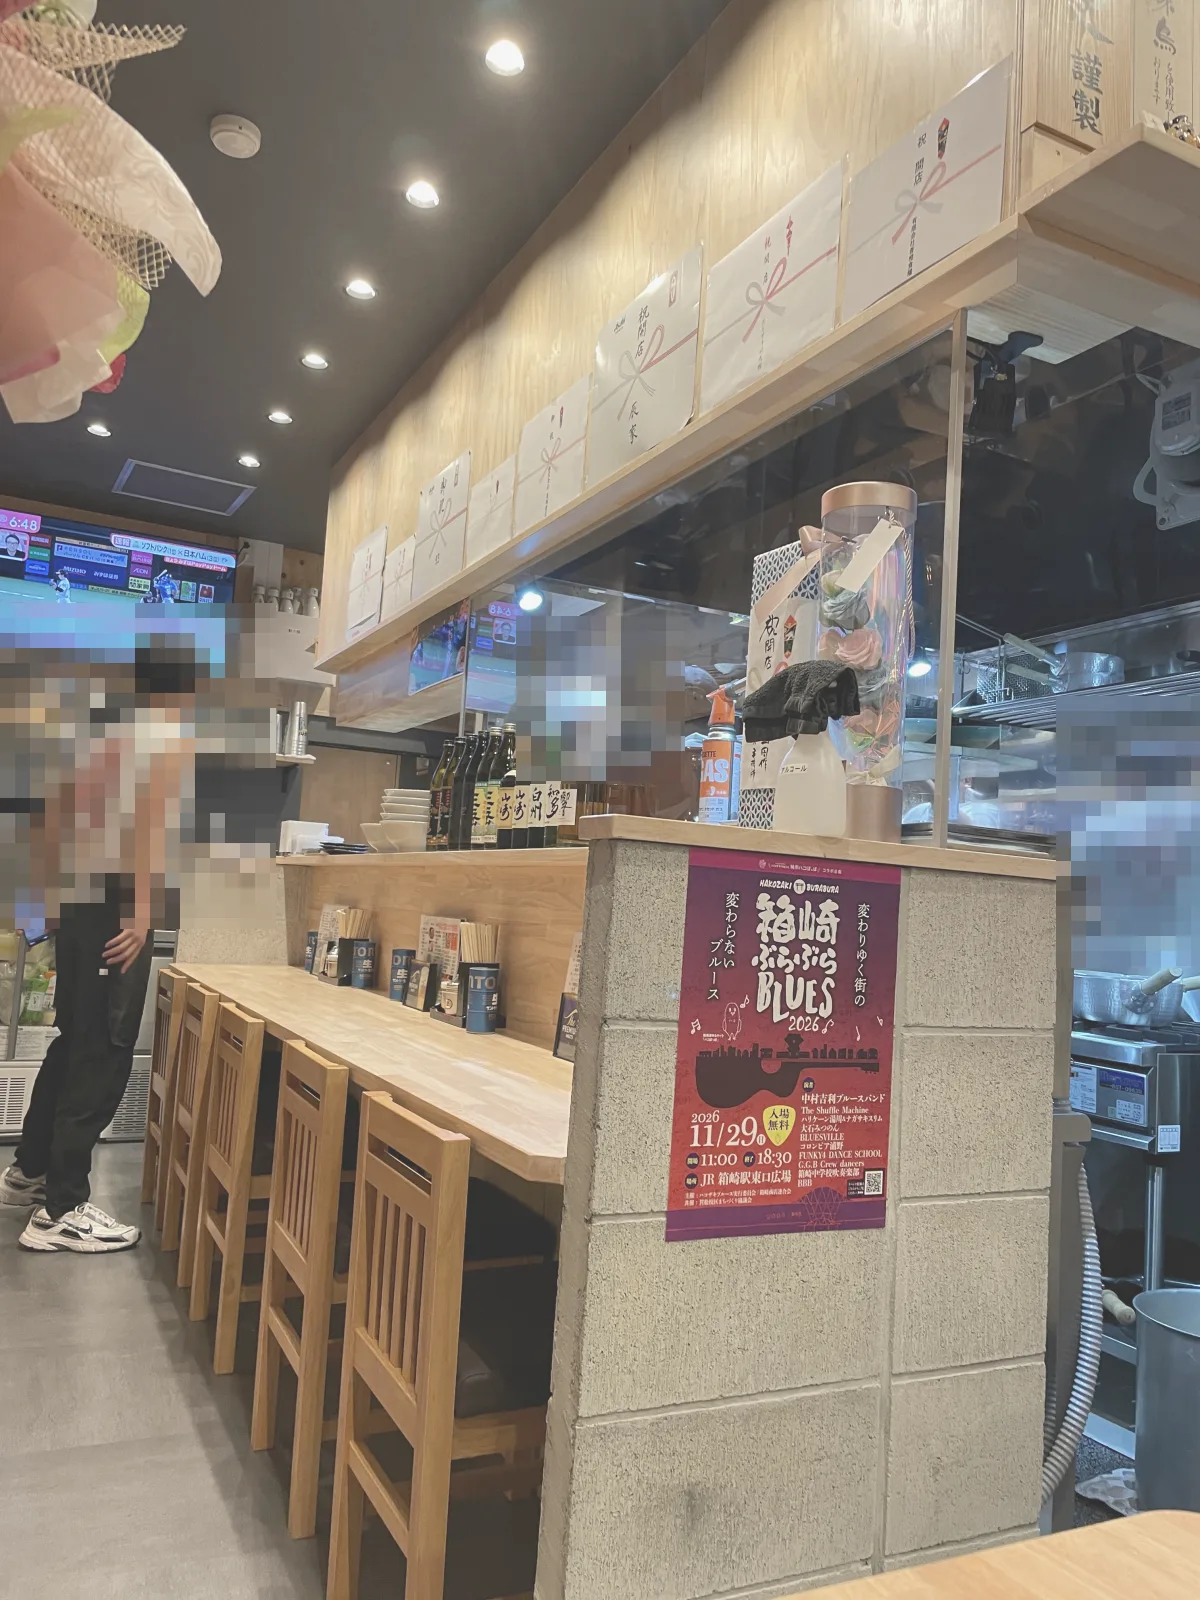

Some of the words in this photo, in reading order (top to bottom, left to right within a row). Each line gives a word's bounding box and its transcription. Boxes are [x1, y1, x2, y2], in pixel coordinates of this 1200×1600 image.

[9, 516, 38, 531] 6:48
[114, 536, 131, 547] 速報
[701, 758, 729, 783] AS
[782, 763, 807, 773] アルコール
[530, 786, 543, 821] 白州
[759, 879, 793, 890] HAKOZAKI
[806, 883, 839, 894] BURABURA
[755, 892, 841, 944] 箱崎
[724, 891, 740, 968] 変わらない
[751, 943, 838, 975] ぶらぶら
[854, 903, 870, 1007] 変わりゆく街の
[396, 968, 408, 979] 生
[707, 939, 724, 1001] ブルース
[756, 971, 836, 1024] BLUES
[788, 1015, 819, 1032] 2026
[801, 1093, 886, 1104] 中村吉利ブルースバンド
[691, 1109, 720, 1123] 2026
[769, 1108, 790, 1119] 入場
[801, 1106, 815, 1115] The
[816, 1106, 840, 1115] Shuffle
[842, 1105, 869, 1114] Machine
[690, 1116, 758, 1148] 11/29
[767, 1120, 790, 1131] 無料
[800, 1132, 845, 1142] BLUESVILLE
[700, 1153, 738, 1167] 11:00
[757, 1148, 792, 1168] 18:30
[799, 1151, 826, 1160] FUNKY4
[829, 1150, 853, 1159] DANCE
[854, 1149, 883, 1158] SCHOOL
[798, 1160, 818, 1169] G.G.B
[820, 1160, 837, 1168] Crew
[840, 1159, 865, 1168] dancers
[700, 1173, 715, 1187] JR
[718, 1169, 792, 1186] 箱崎駅東口広場
[798, 1167, 860, 1178] 箱崎中学校吹奏楽部
[797, 1179, 813, 1187] BBB
